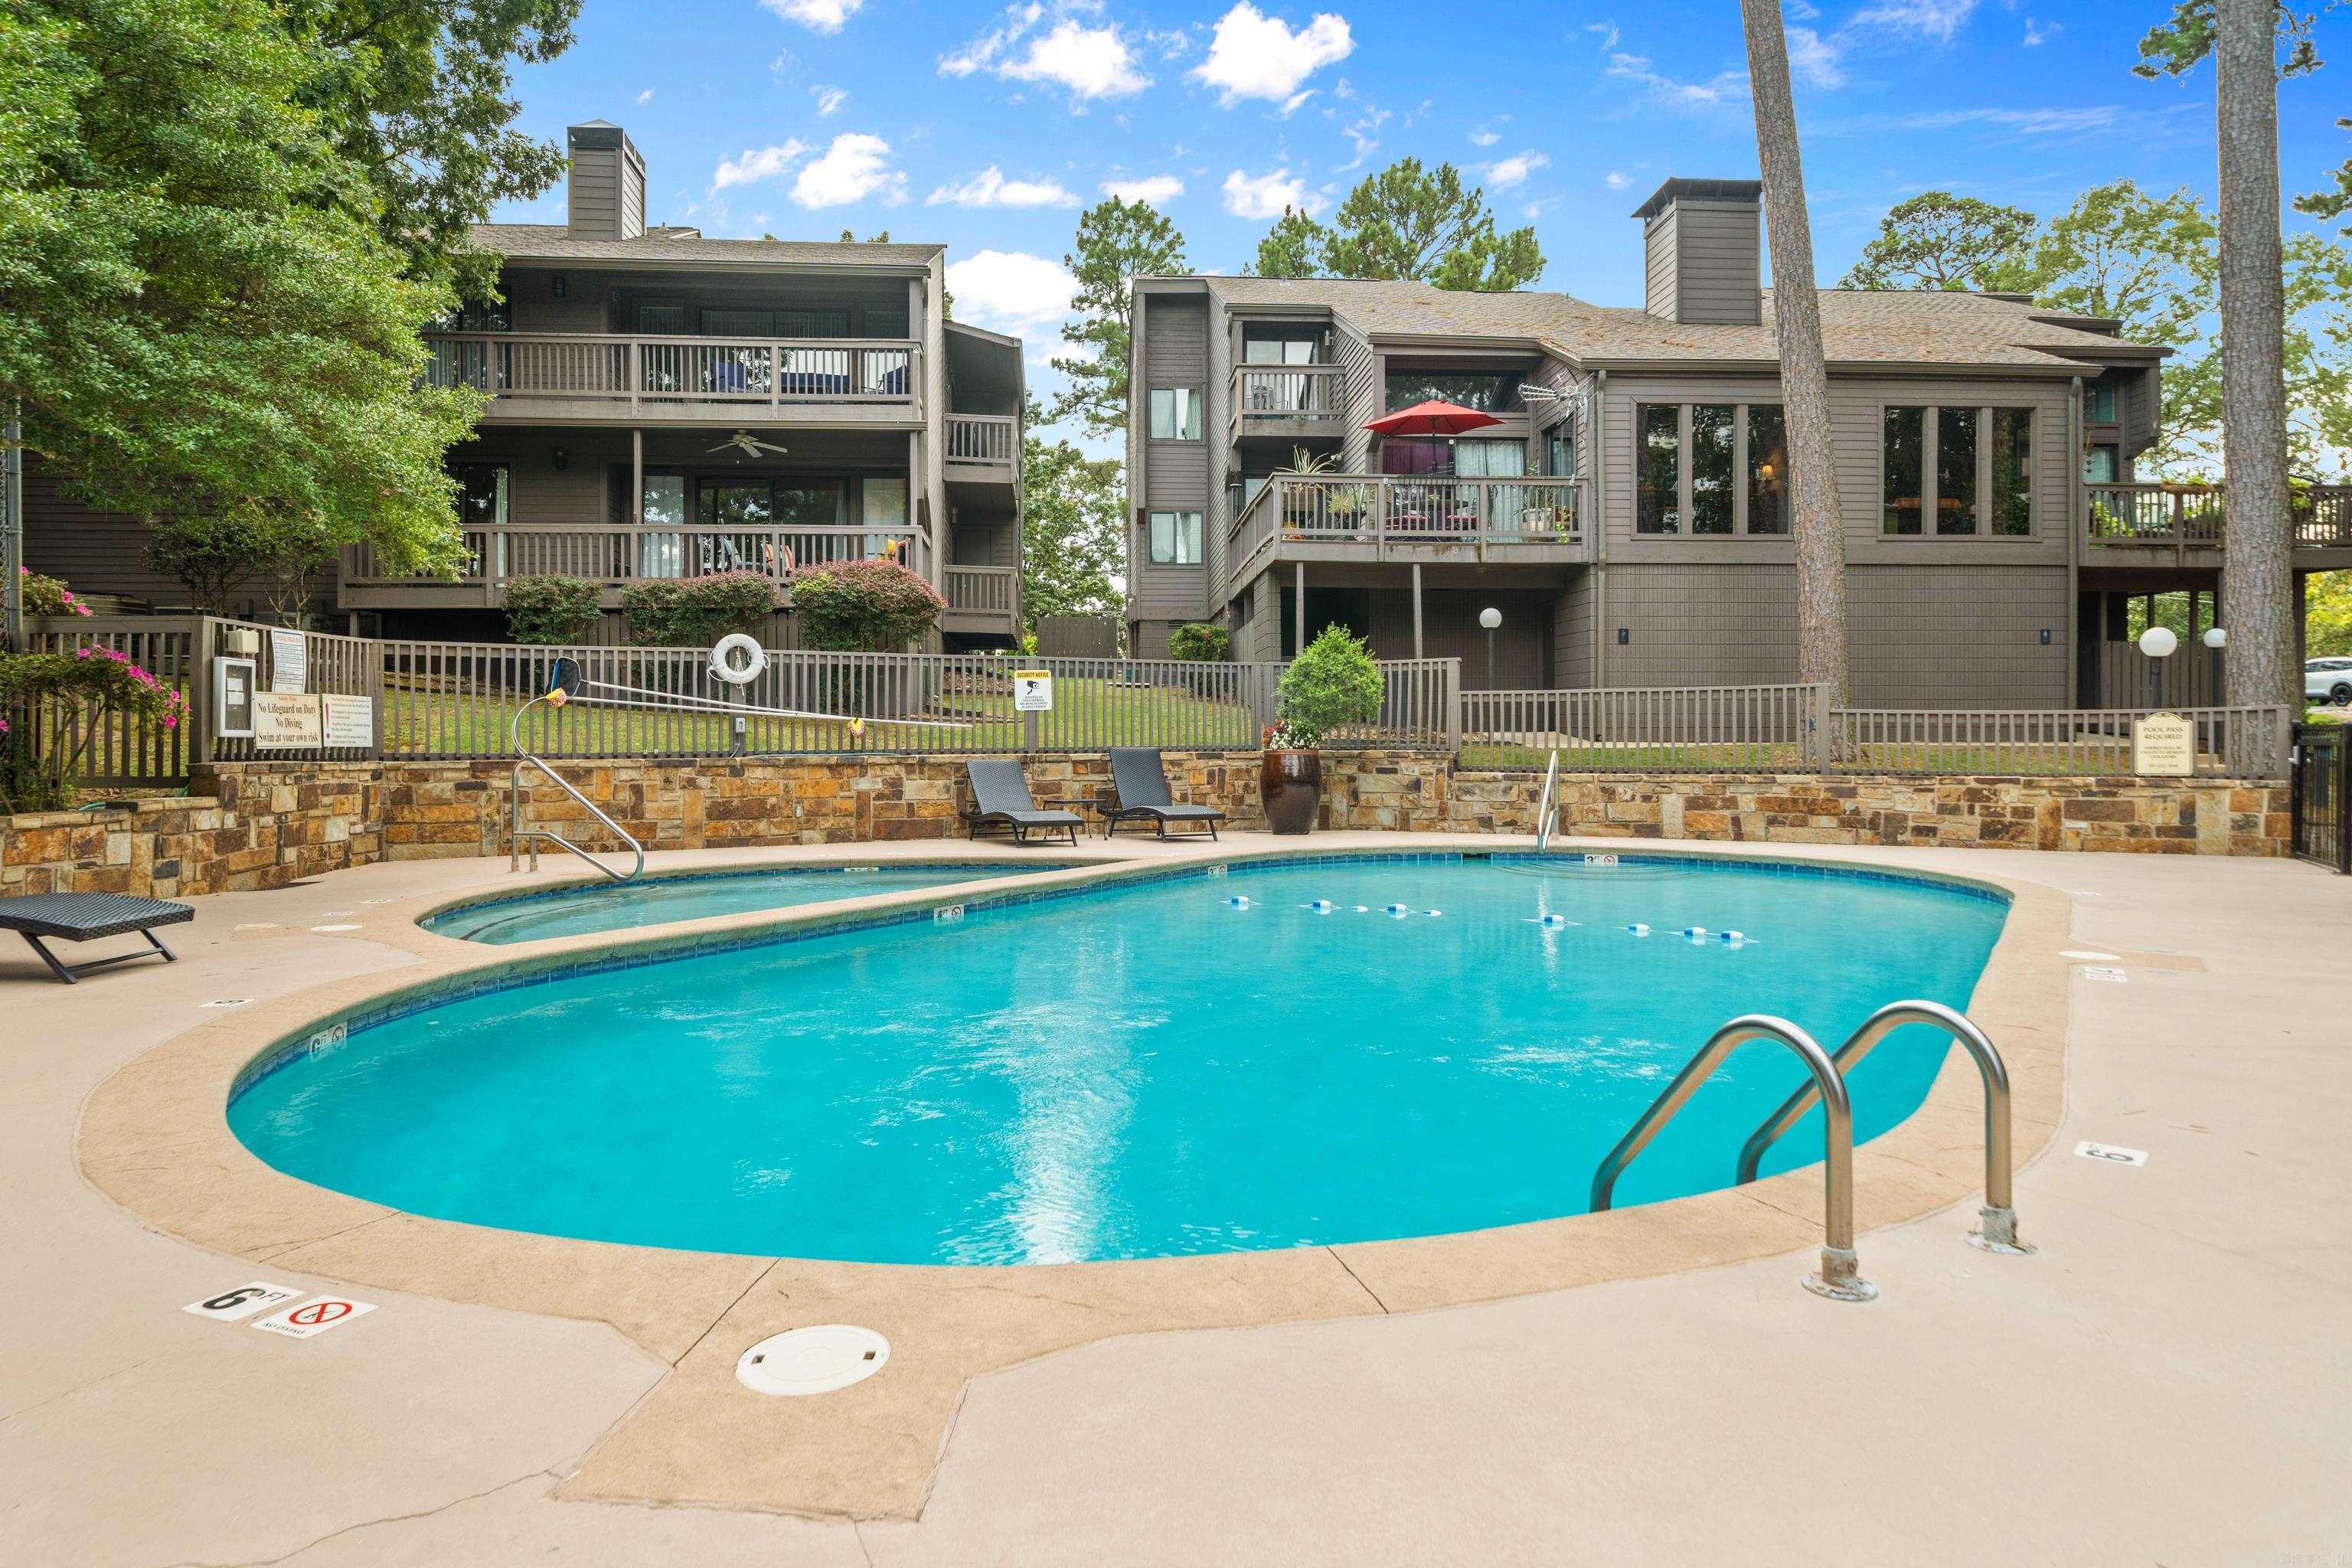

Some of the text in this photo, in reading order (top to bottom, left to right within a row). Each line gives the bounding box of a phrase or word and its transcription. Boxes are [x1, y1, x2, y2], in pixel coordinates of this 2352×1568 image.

[258, 703, 266, 713] No
[268, 703, 294, 716] Lifeguard
[304, 704, 316, 717] Duty
[276, 718, 302, 730] No Diving
[258, 731, 274, 743] Swim
[276, 733, 282, 742] at
[283, 734, 295, 745] your
[309, 732, 318, 743] risk
[202, 1288, 289, 1310] 6 FT
